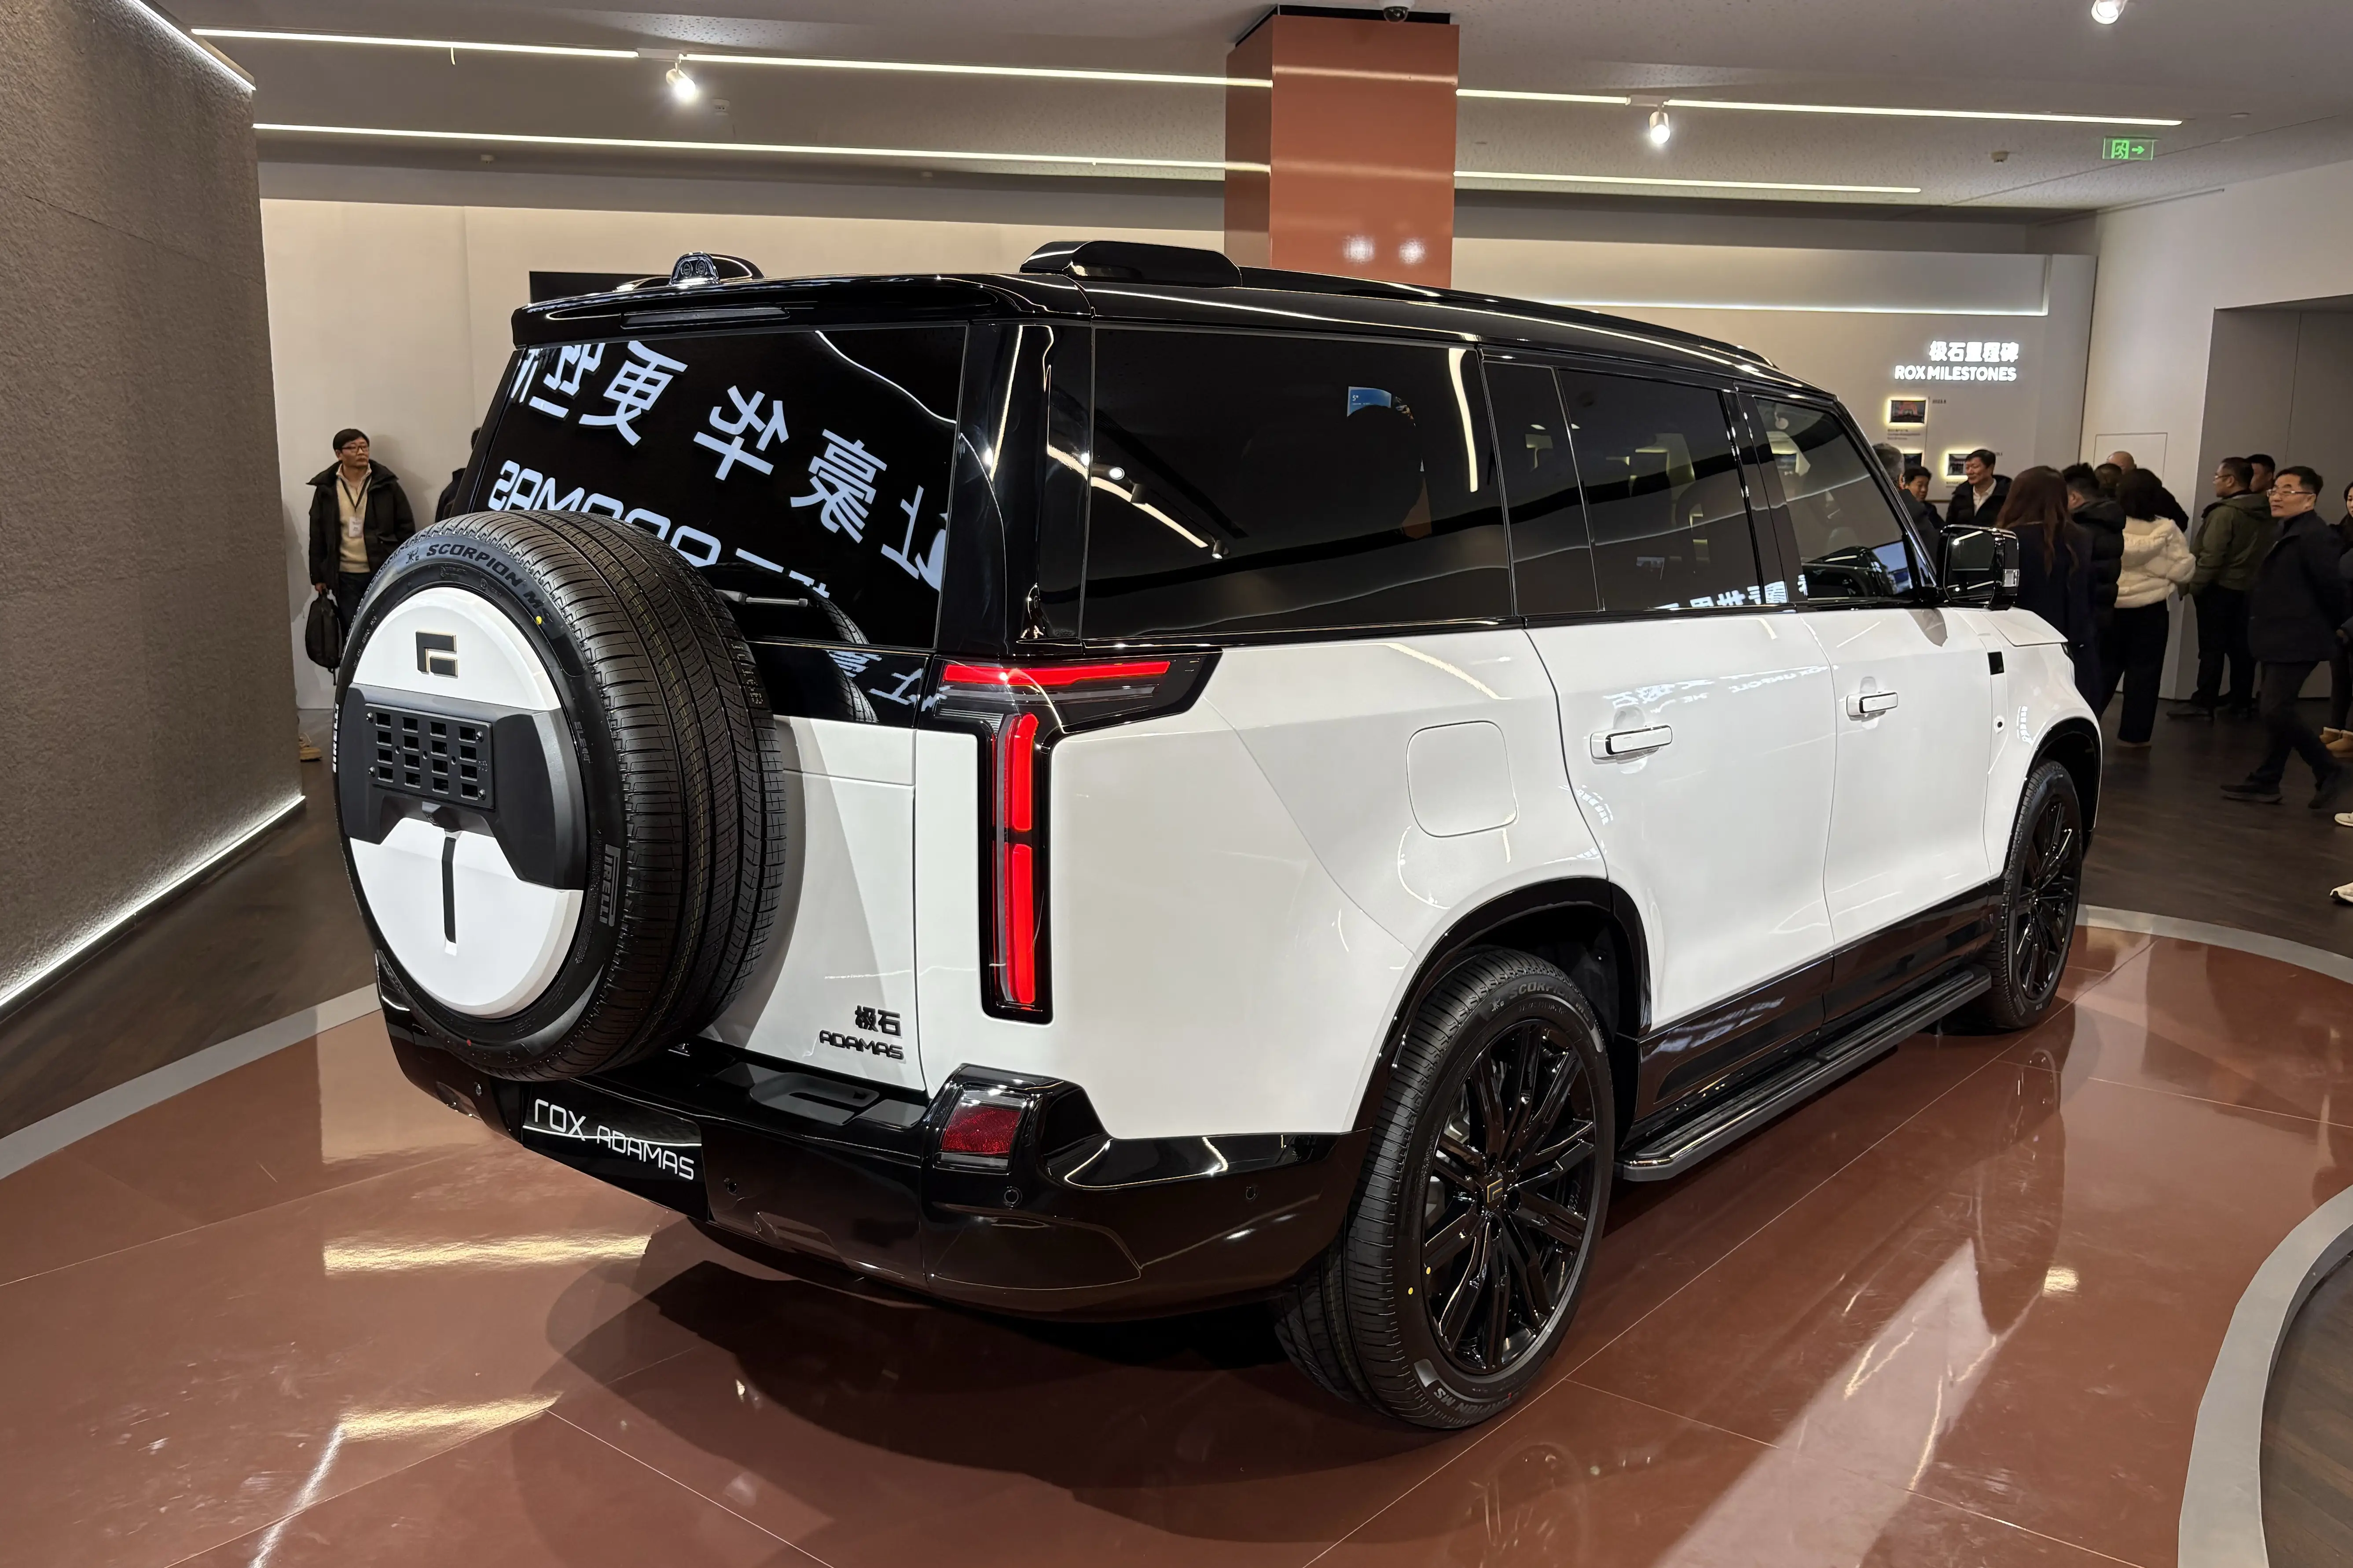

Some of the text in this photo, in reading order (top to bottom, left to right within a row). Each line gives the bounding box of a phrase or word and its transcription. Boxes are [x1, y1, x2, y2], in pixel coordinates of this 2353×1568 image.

[1894, 365, 2017, 381] ROX MILESTONES
[426, 544, 523, 587] SCORPION
[599, 844, 621, 927] PIRELLI
[854, 1005, 901, 1037] 极石
[819, 1029, 904, 1060] ADAMAS
[597, 1125, 694, 1180] ADAMAS
[1433, 1387, 1456, 1407] MS
